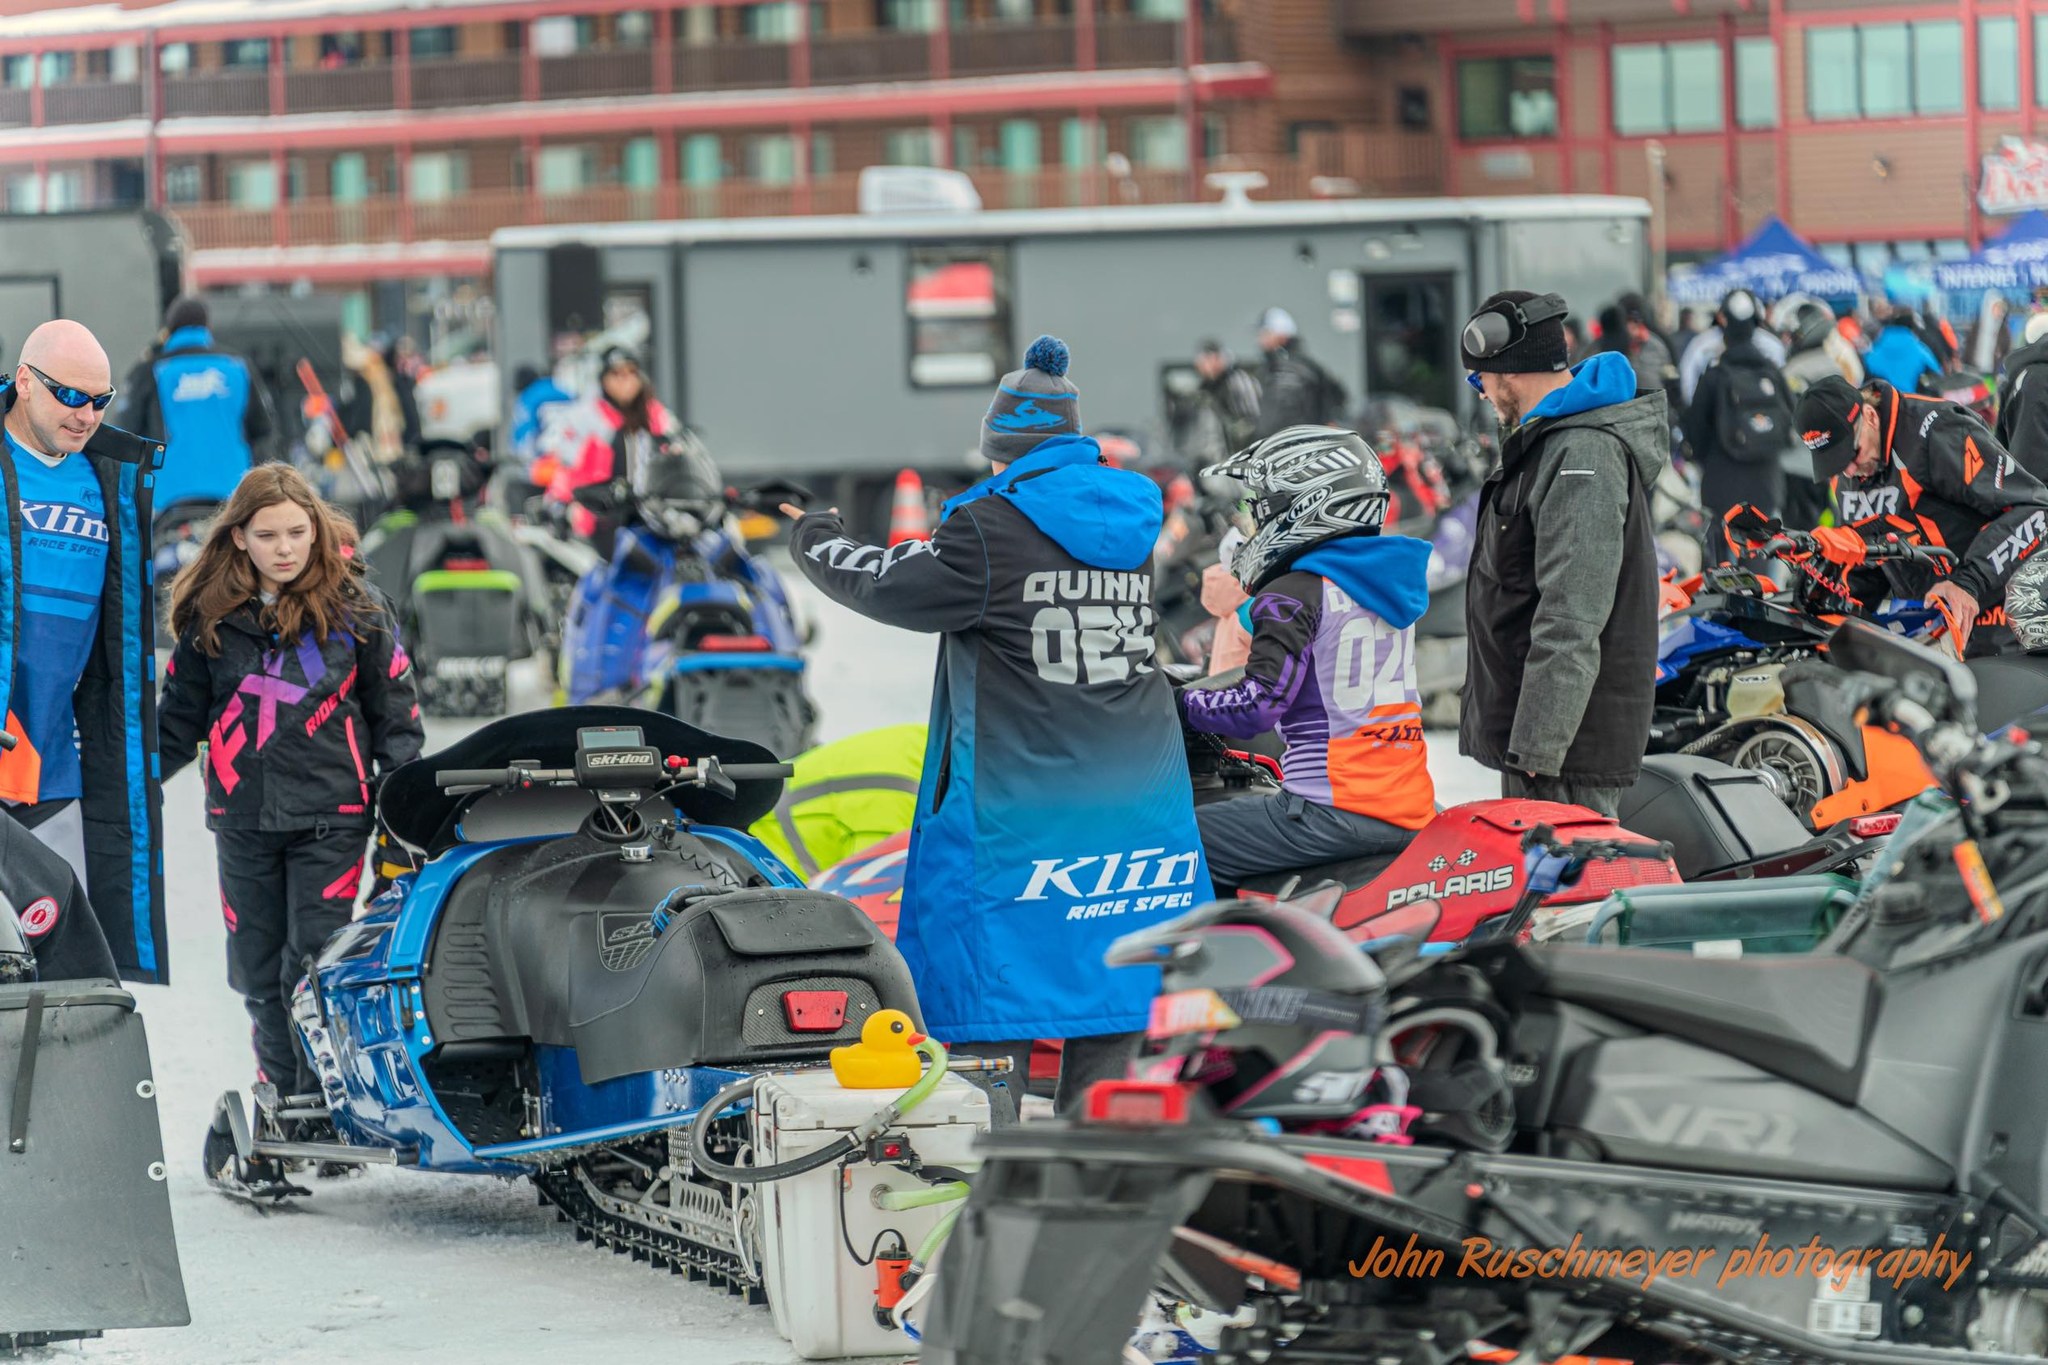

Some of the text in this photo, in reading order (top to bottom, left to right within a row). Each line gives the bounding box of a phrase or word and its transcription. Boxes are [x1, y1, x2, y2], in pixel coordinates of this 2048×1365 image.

[1293, 490, 1324, 517] HJC
[1840, 486, 1900, 520] FXR
[28, 537, 101, 557] RACE SPEC
[1987, 510, 2046, 575] FXR
[1023, 570, 1151, 605] QUINN
[305, 692, 339, 738] RIDE
[590, 754, 650, 766] ski-doo
[1386, 865, 1514, 911] POLARIS
[1066, 891, 1192, 920] RACE SPEC
[1613, 1096, 1799, 1158] VR1
